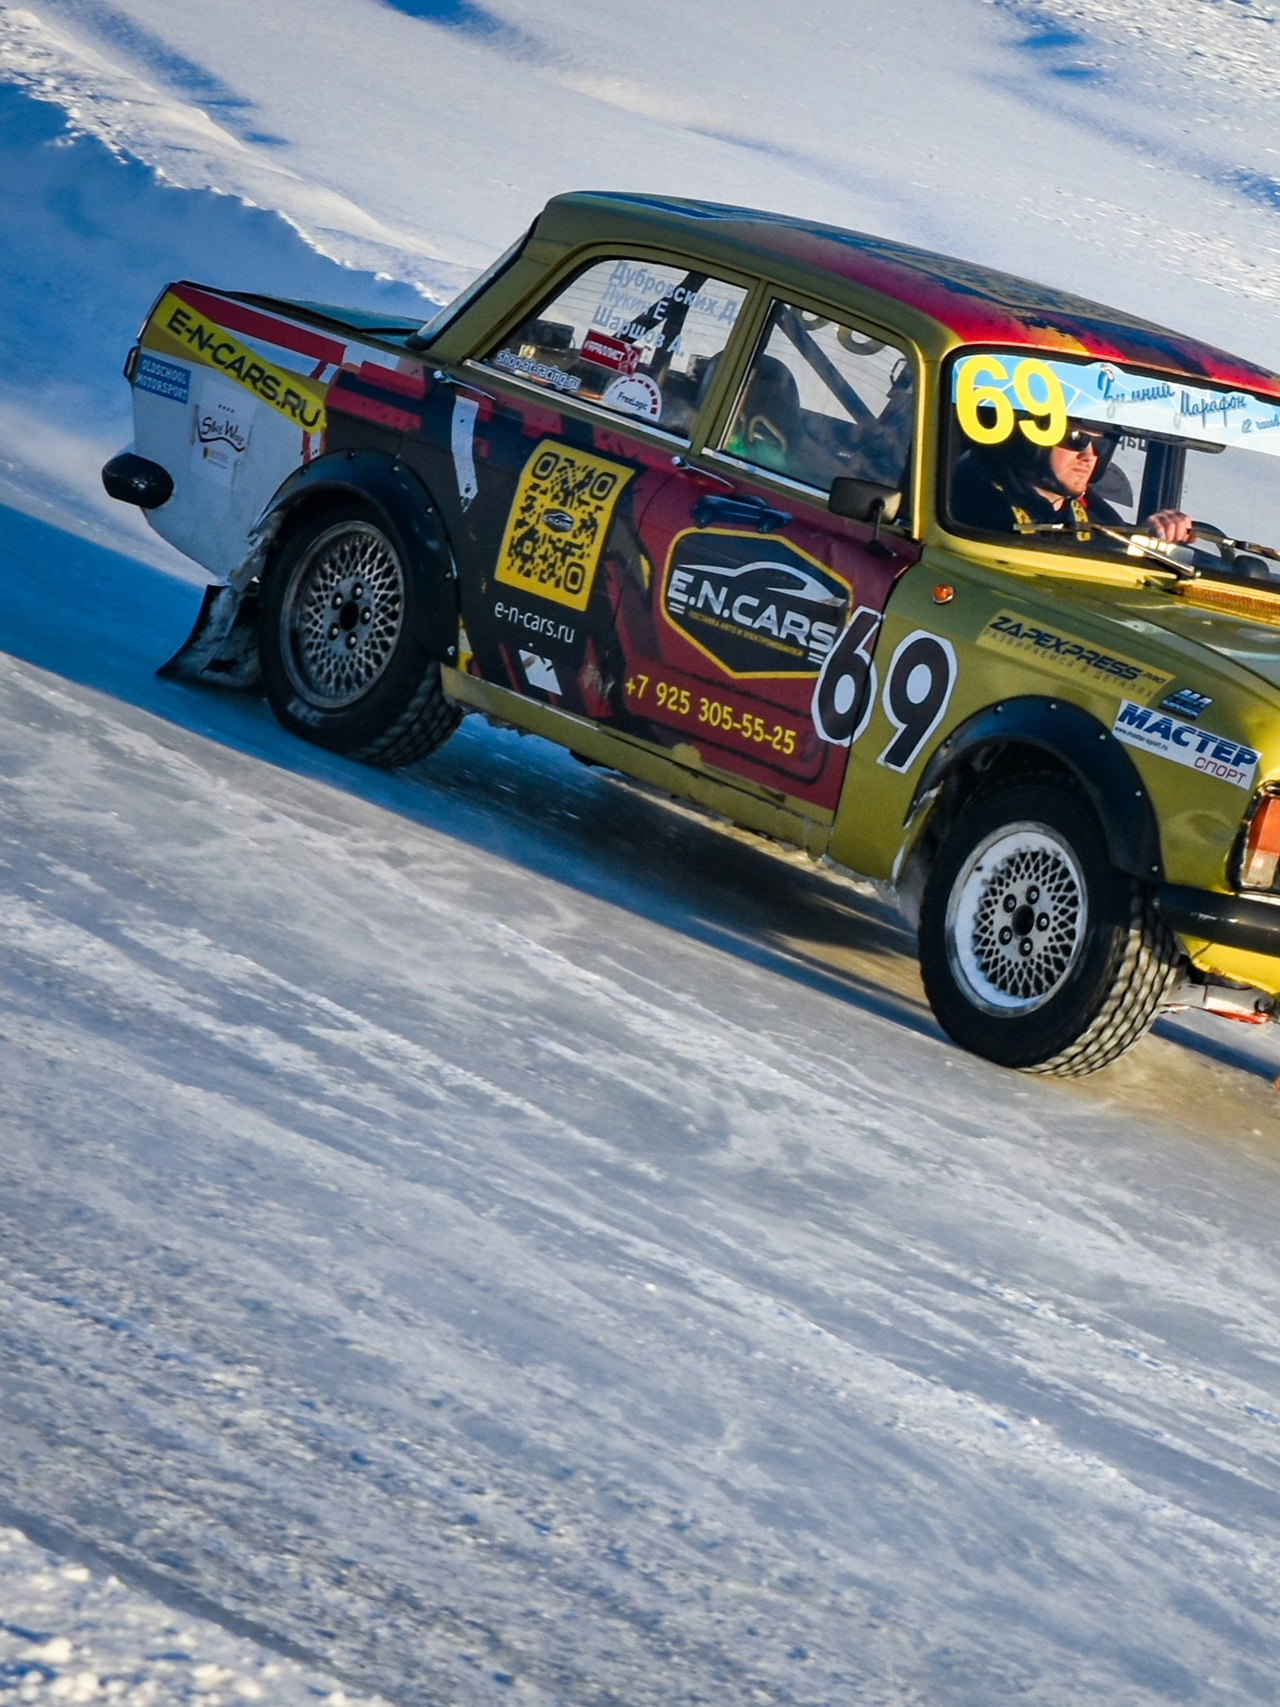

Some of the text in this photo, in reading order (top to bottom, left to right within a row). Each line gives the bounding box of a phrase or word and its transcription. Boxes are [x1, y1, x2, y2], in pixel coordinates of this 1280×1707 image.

[609, 261, 719, 313] Дубровских
[592, 305, 666, 348] Шаршов
[135, 374, 188, 401] MOTORSPORT
[141, 359, 187, 385] OLDSCHOOL
[166, 308, 322, 427] E-N-CARS.RU
[956, 355, 1067, 447] 69
[494, 602, 575, 644] e-n-cars.ru
[667, 569, 837, 654] E.N.CARS
[625, 674, 796, 756] +7 925 305-55-25
[811, 605, 957, 774] 69
[1117, 703, 1258, 768] МАСТЕР
[1194, 756, 1247, 785] СПОРТ
